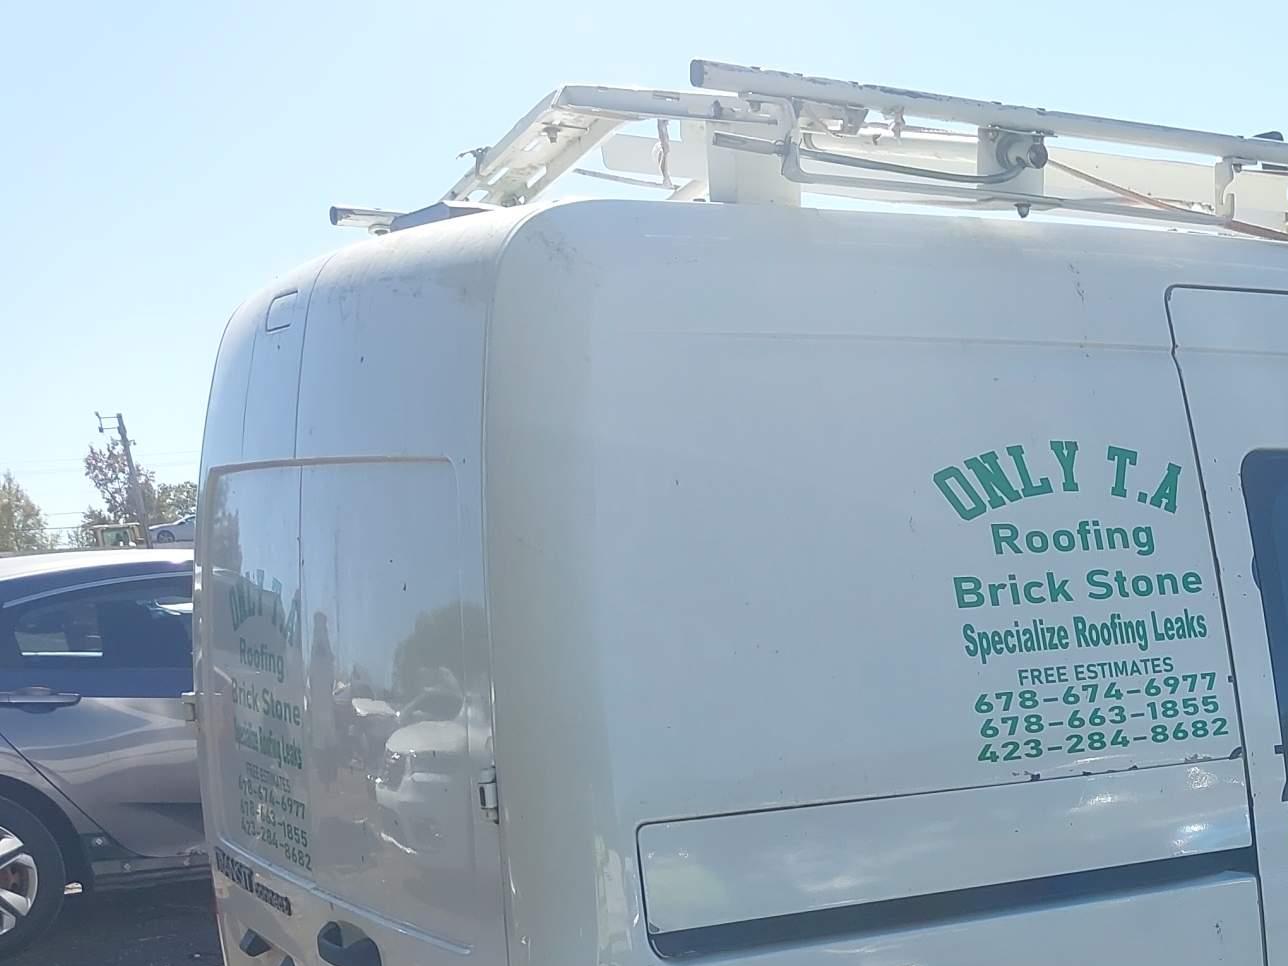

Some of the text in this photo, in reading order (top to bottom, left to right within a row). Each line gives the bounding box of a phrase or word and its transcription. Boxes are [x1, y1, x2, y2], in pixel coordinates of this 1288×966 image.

[933, 440, 1182, 521] ONLY T.A
[990, 520, 1155, 556] Roofing
[953, 569, 1203, 609] Brick Stone
[962, 608, 1207, 664] Specialize Roofing Leaks
[240, 637, 284, 683] Roofing
[1018, 657, 1174, 686] FREE ESTIMATES
[232, 678, 301, 726] Brick Stone
[974, 672, 1217, 714] 678-674-6977
[980, 695, 1220, 738] 678-663-1855
[977, 717, 1229, 763] 423-284-8682
